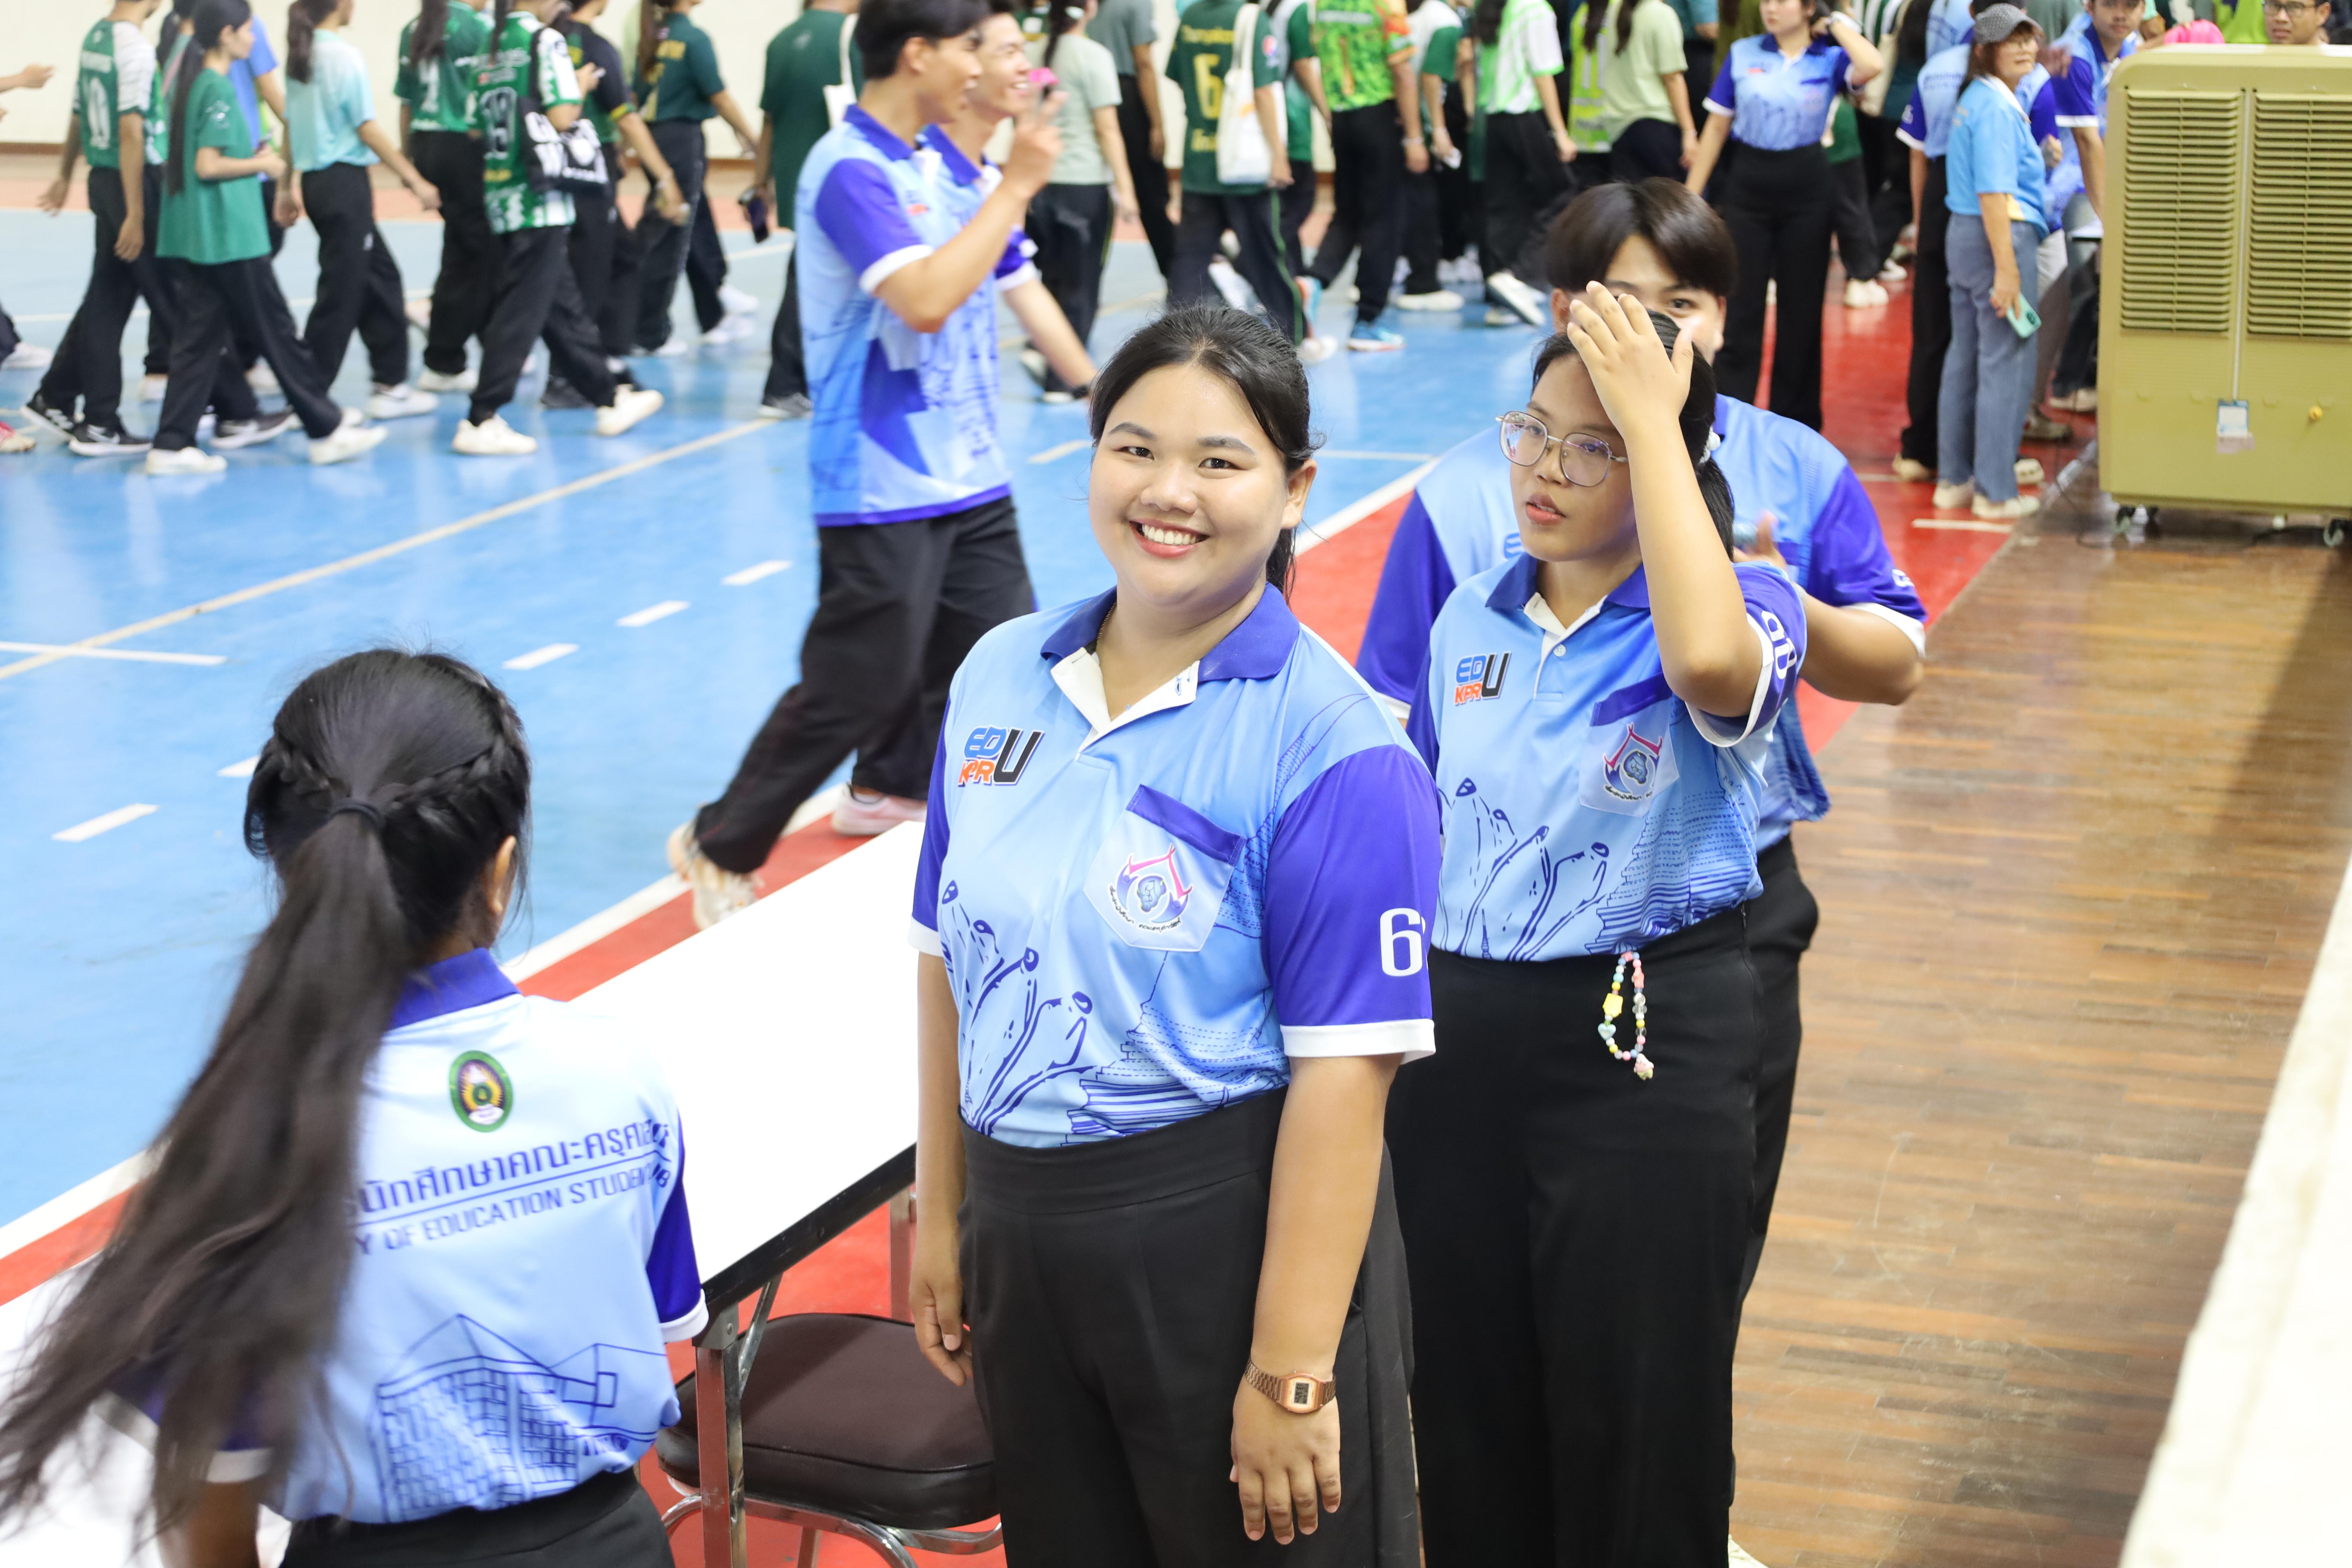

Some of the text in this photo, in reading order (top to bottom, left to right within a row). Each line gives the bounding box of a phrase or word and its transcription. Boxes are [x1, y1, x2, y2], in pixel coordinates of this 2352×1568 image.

[1380, 908, 1428, 977] 6
[384, 1224, 414, 1250] OF
[422, 1188, 562, 1240] EDUCATION
